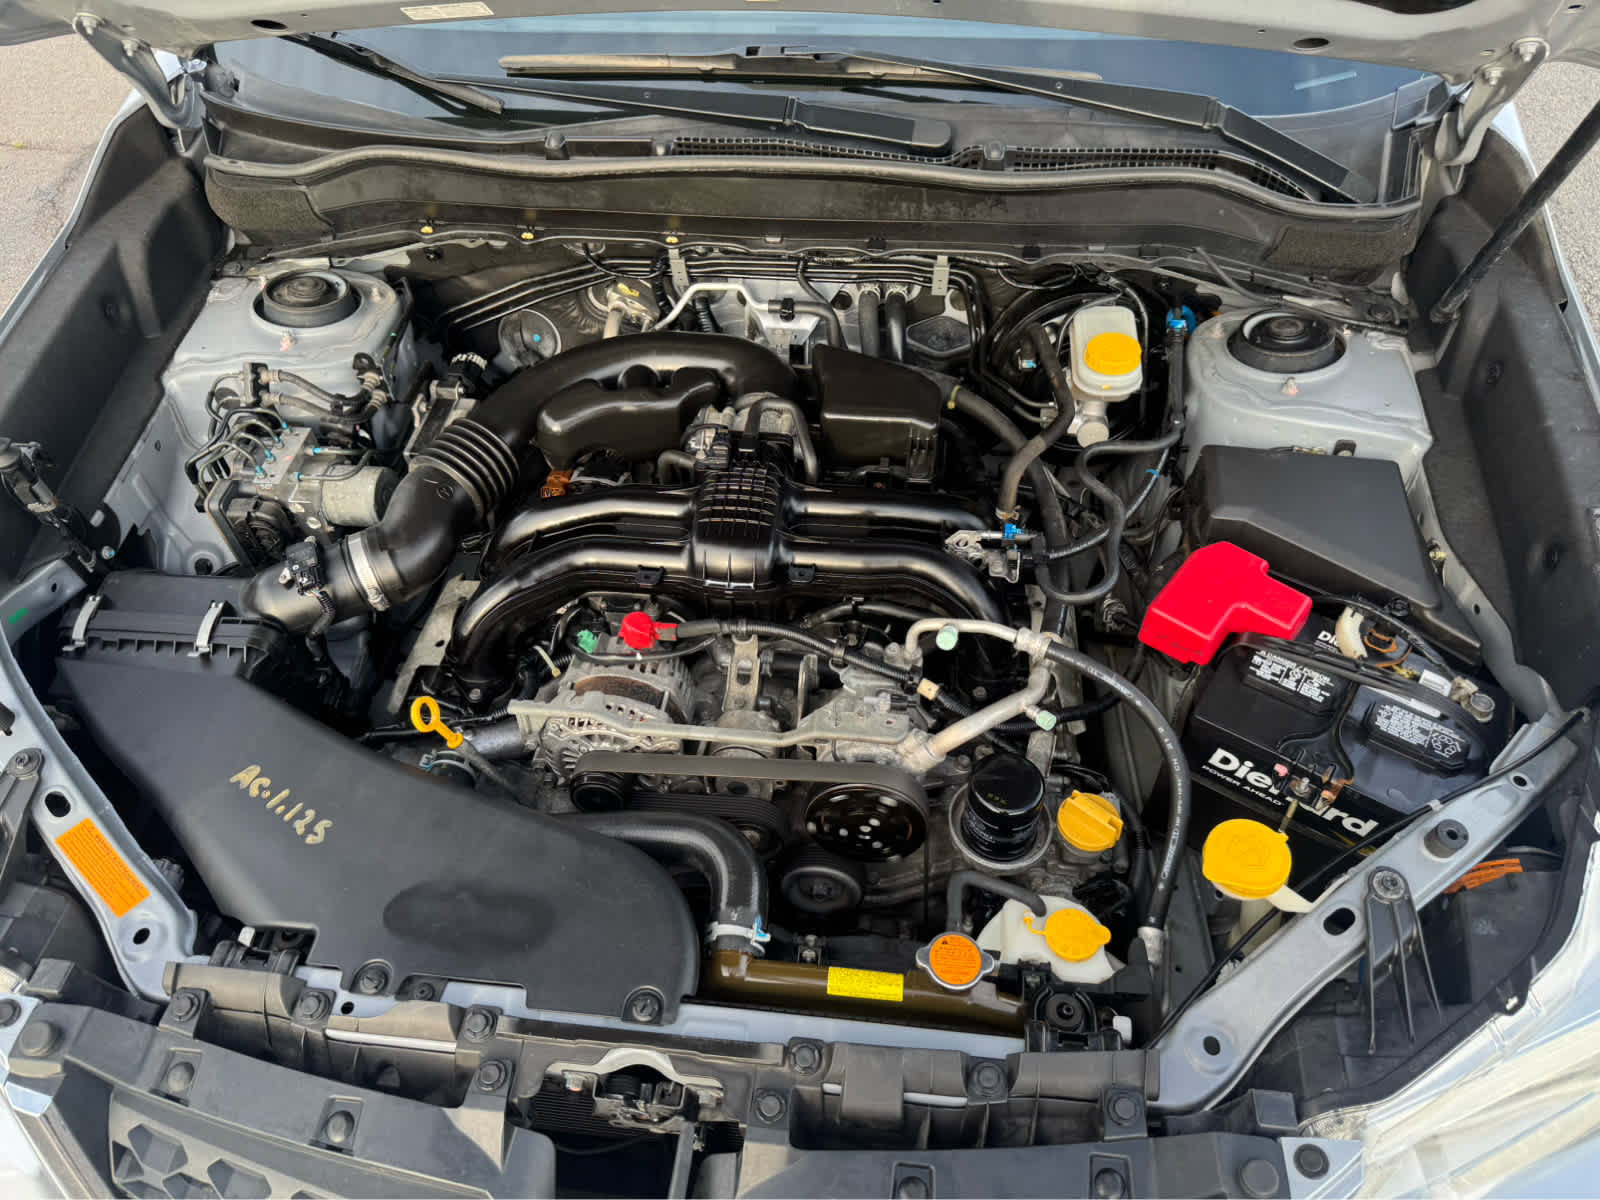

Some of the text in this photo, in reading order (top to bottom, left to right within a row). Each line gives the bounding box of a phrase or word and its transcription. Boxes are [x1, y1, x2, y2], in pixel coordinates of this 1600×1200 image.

[1201, 764, 1282, 806] POWER AHEAD
[1208, 747, 1380, 837] Dieard
